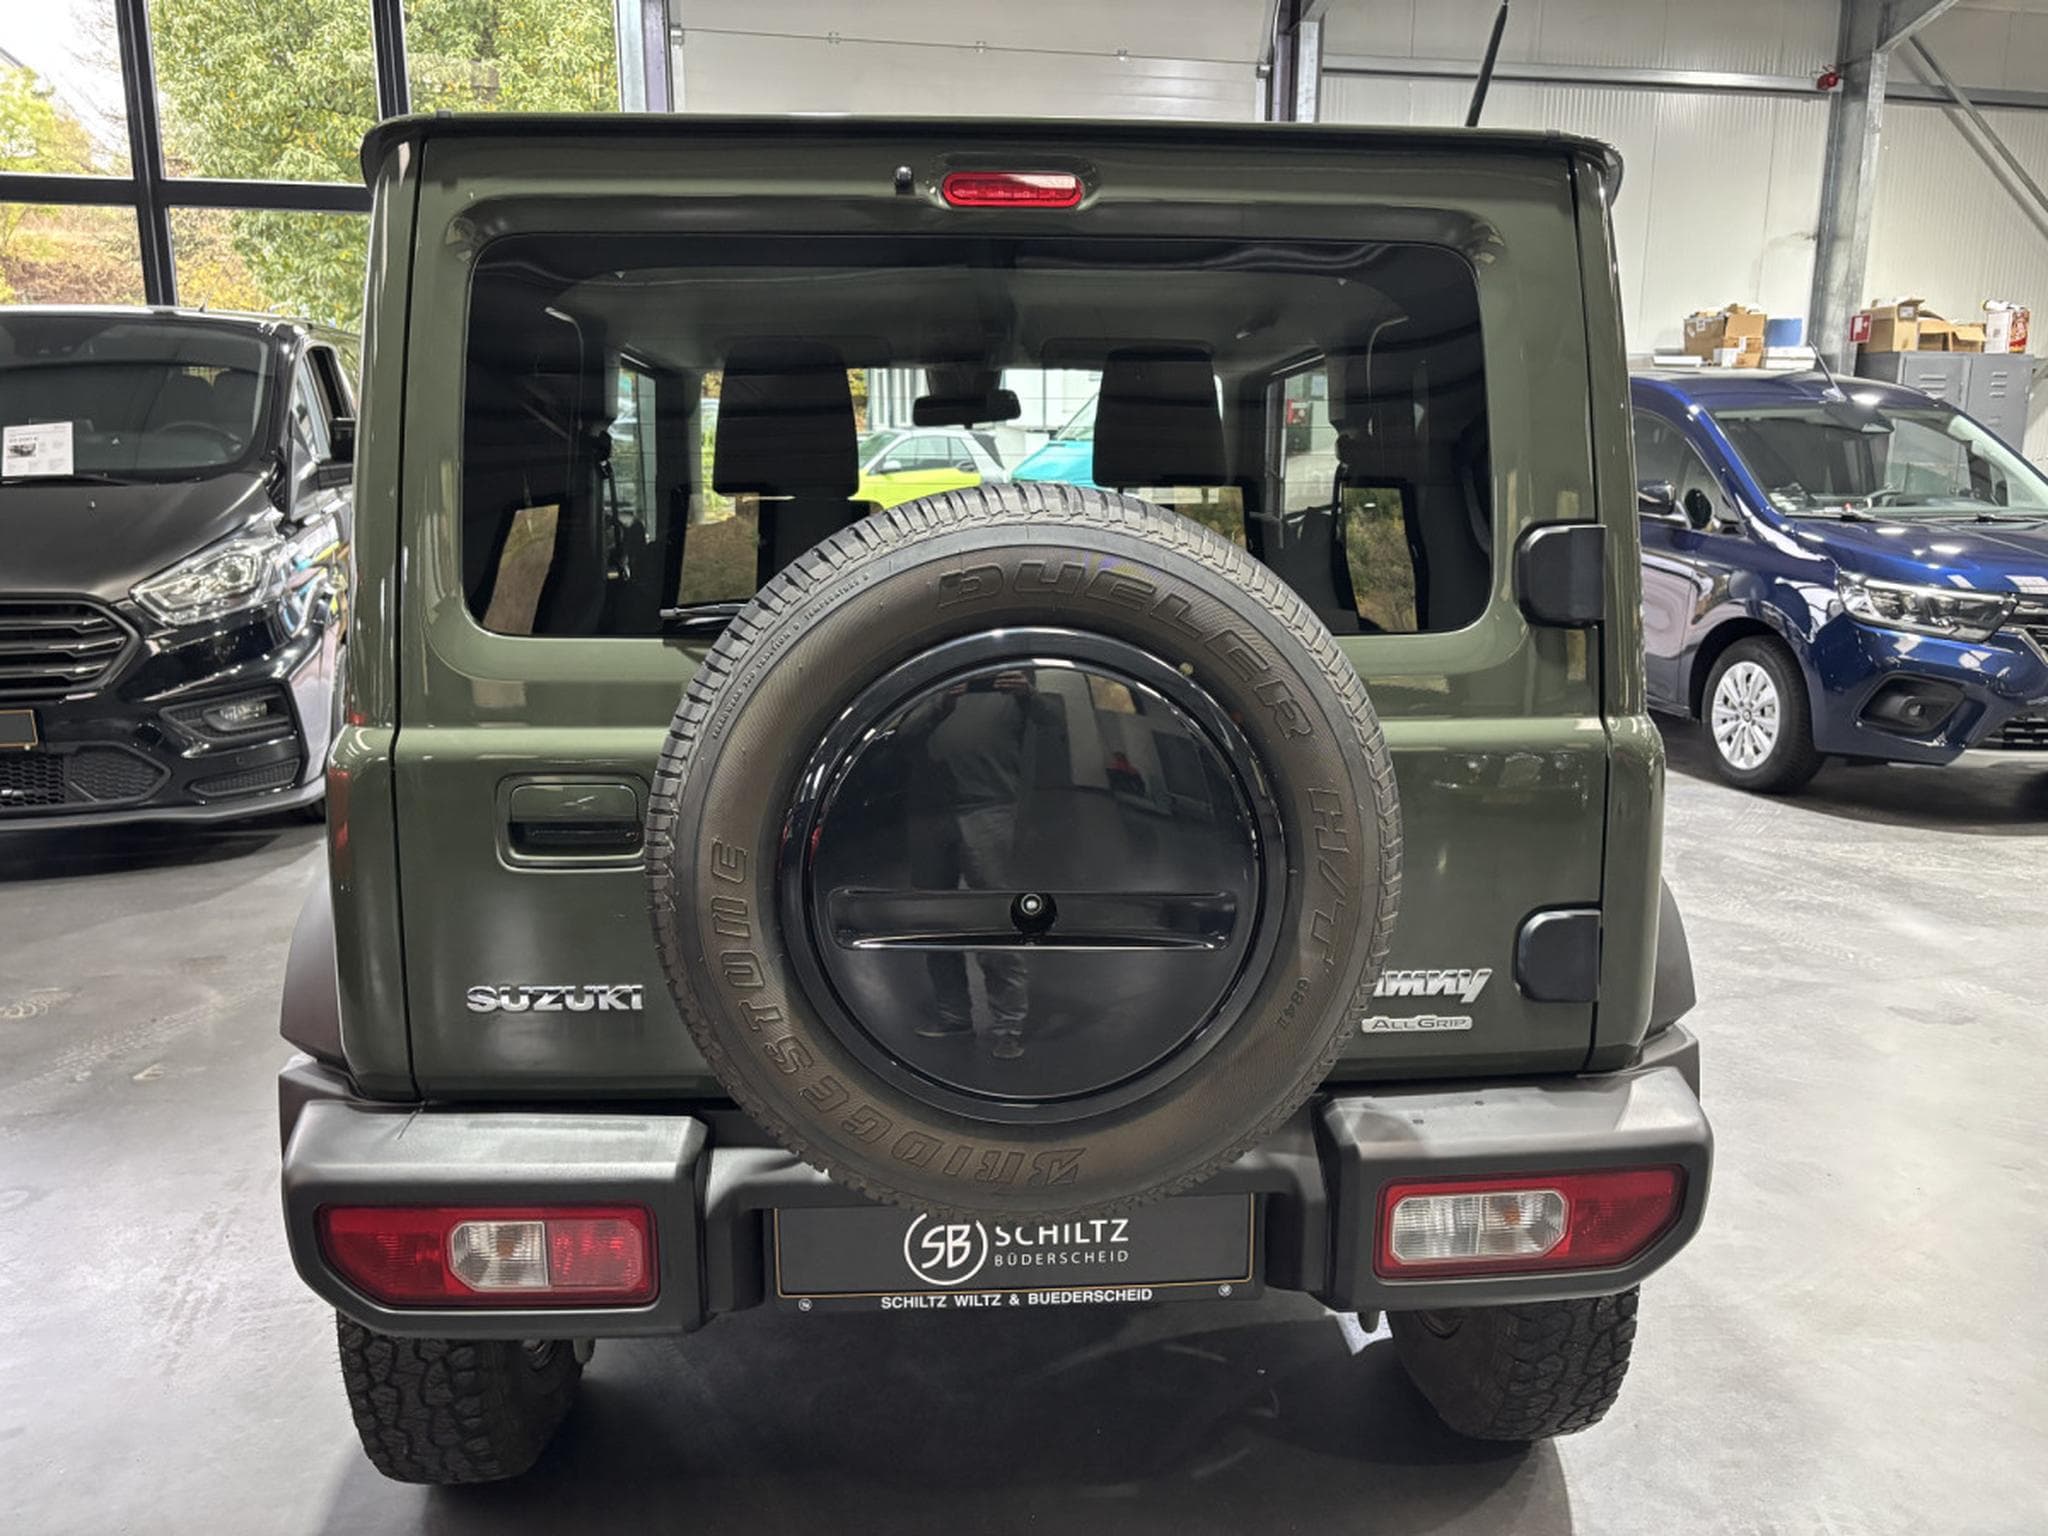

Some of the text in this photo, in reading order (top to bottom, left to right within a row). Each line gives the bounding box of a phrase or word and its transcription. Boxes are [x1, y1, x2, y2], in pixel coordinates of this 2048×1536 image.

[936, 559, 1313, 741] DUELER
[466, 985, 643, 1013] SUZUKI
[1372, 967, 1493, 1003] imny
[710, 835, 1087, 1186] BRIDGESTONE
[921, 1224, 971, 1269] SB
[994, 1218, 1130, 1247] SCHILTZ
[994, 1250, 1130, 1267] BÜDERSCHEID
[880, 1288, 1153, 1310] SCHILTZ WILTZ & BUEDERSCHEID
